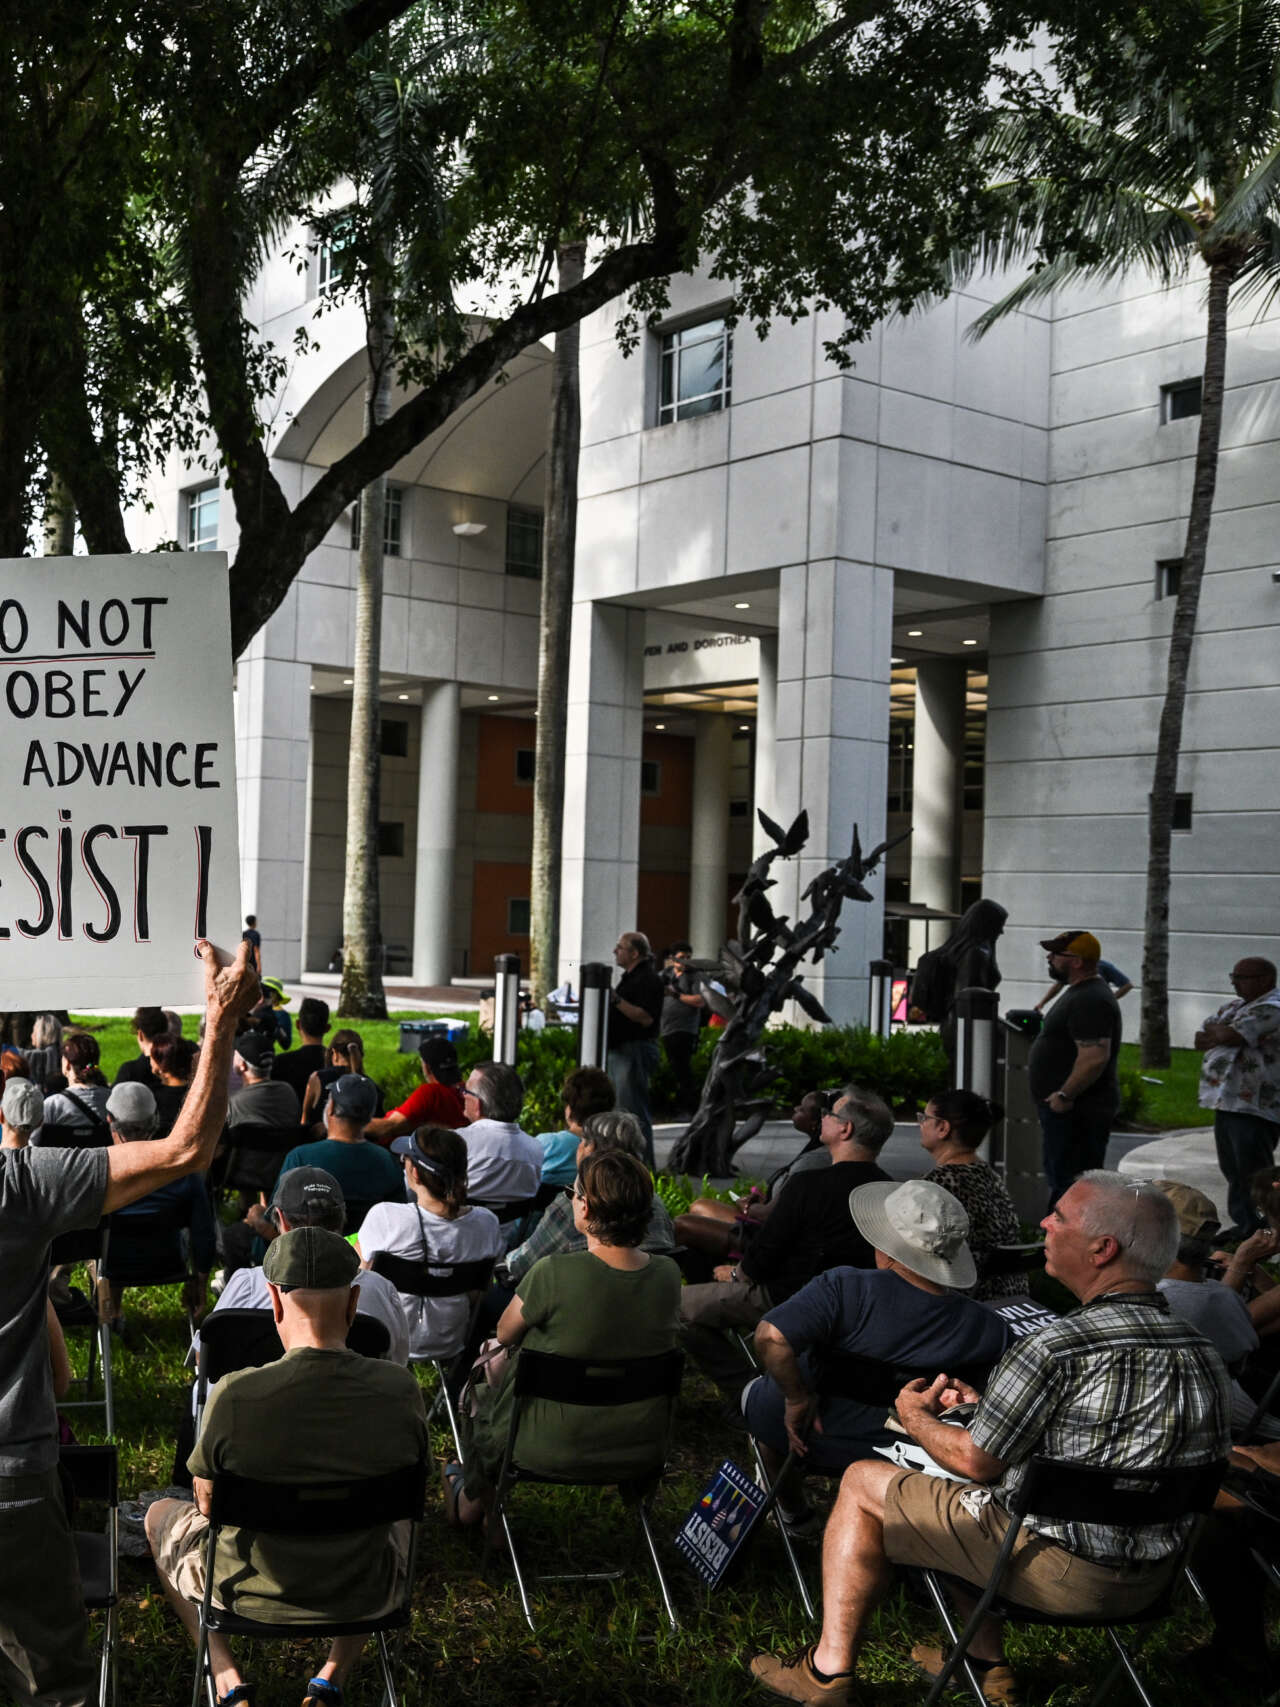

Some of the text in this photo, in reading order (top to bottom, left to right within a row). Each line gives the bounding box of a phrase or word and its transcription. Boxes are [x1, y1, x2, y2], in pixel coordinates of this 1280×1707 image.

[57, 597, 168, 649] NOT
[666, 641, 689, 654] AND
[6, 668, 146, 719] OBEY
[23, 739, 220, 788] ADVANCE
